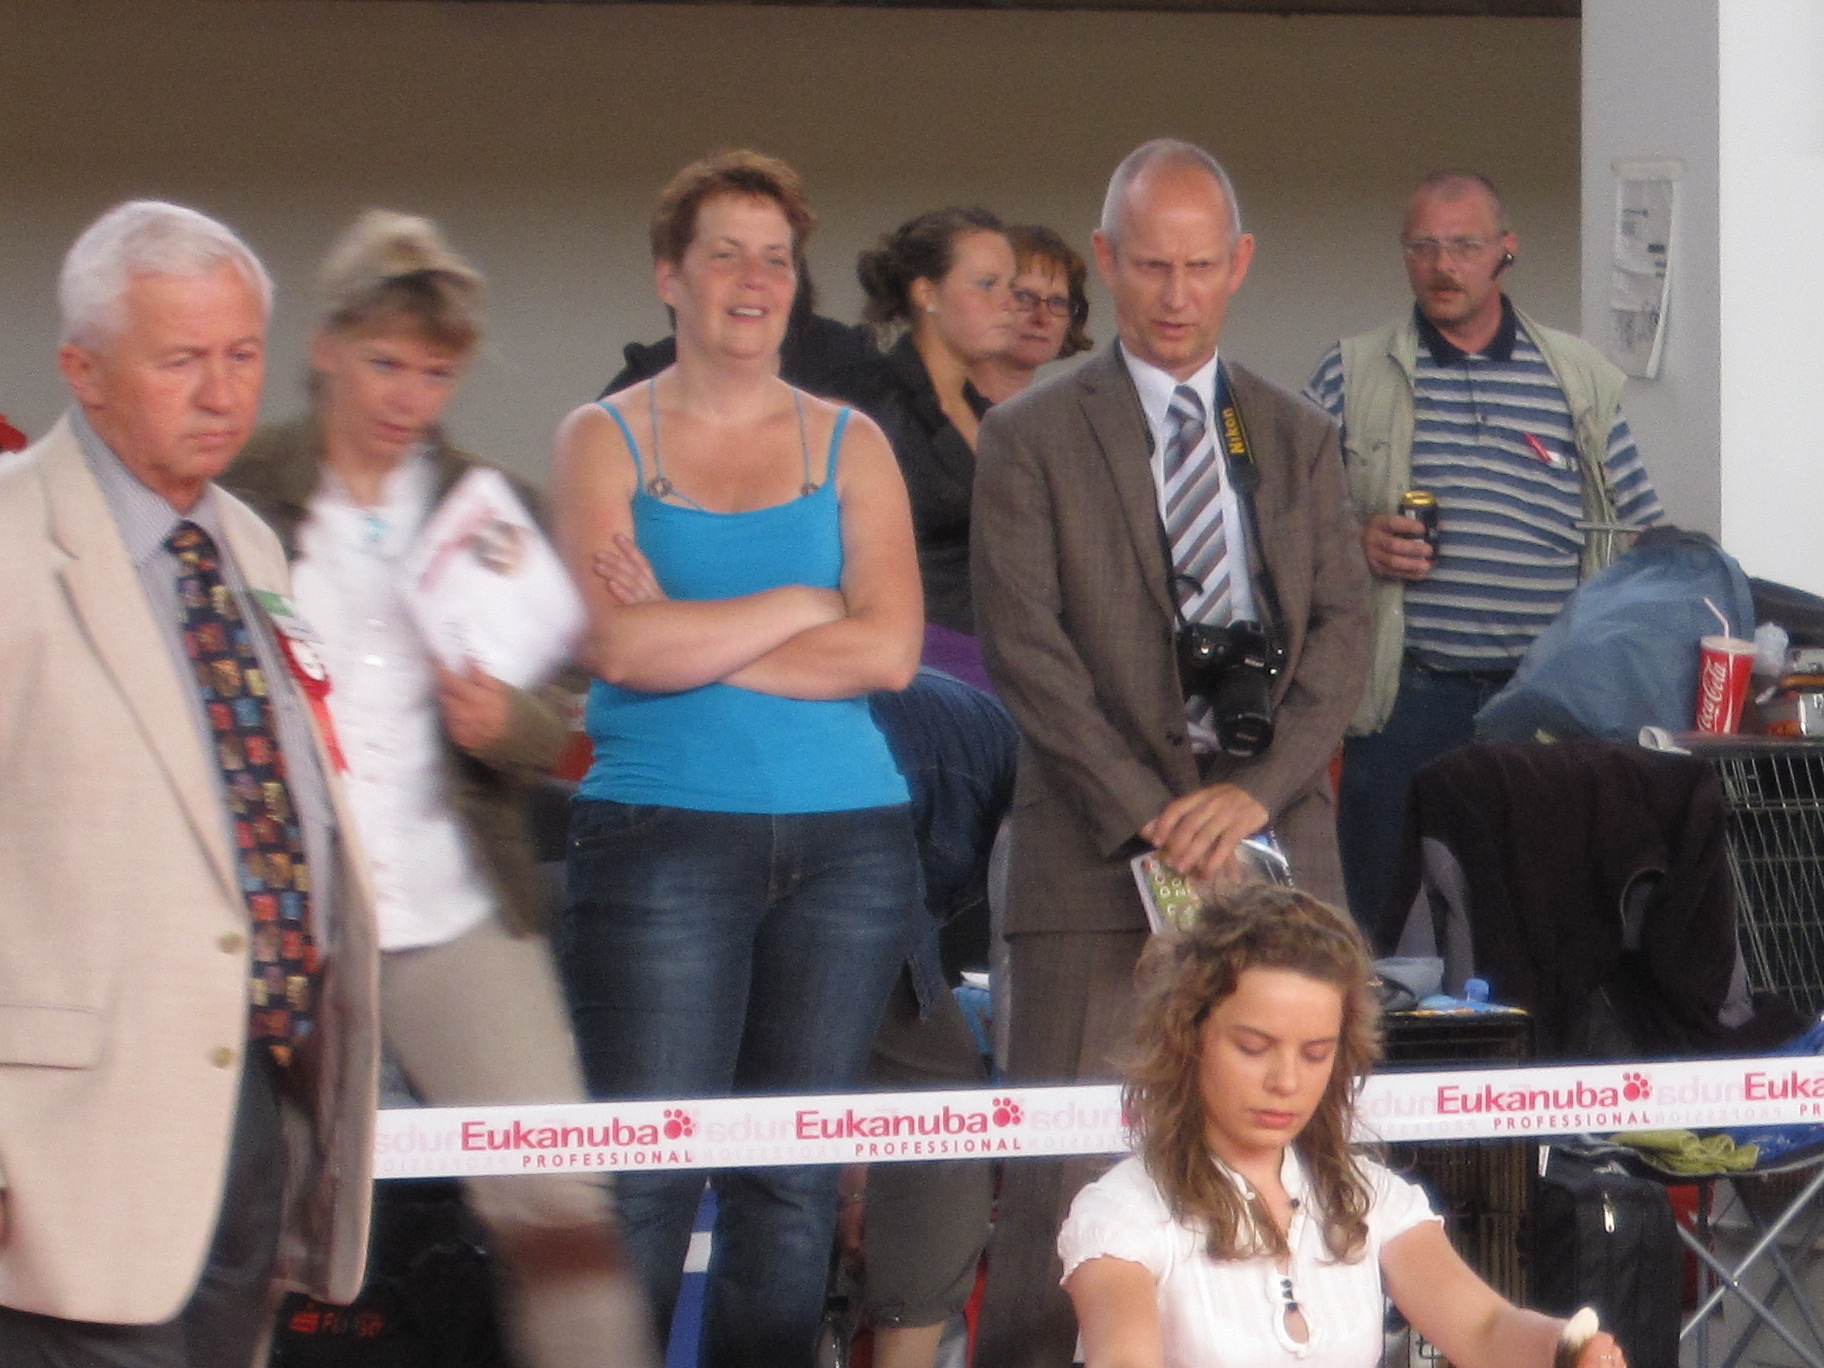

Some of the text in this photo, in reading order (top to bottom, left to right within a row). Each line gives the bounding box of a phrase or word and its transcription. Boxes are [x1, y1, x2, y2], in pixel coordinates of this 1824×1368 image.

[1222, 406, 1245, 454] Nikon
[1437, 1081, 1619, 1115] Eukanuba
[461, 1117, 659, 1152] Eukanuba
[795, 1106, 988, 1140] Eukanuba
[1494, 1111, 1651, 1131] PROFESSIONAL
[522, 1149, 694, 1168] PROFESSIONAL
[855, 1137, 1022, 1157] PROFESSIONAL
